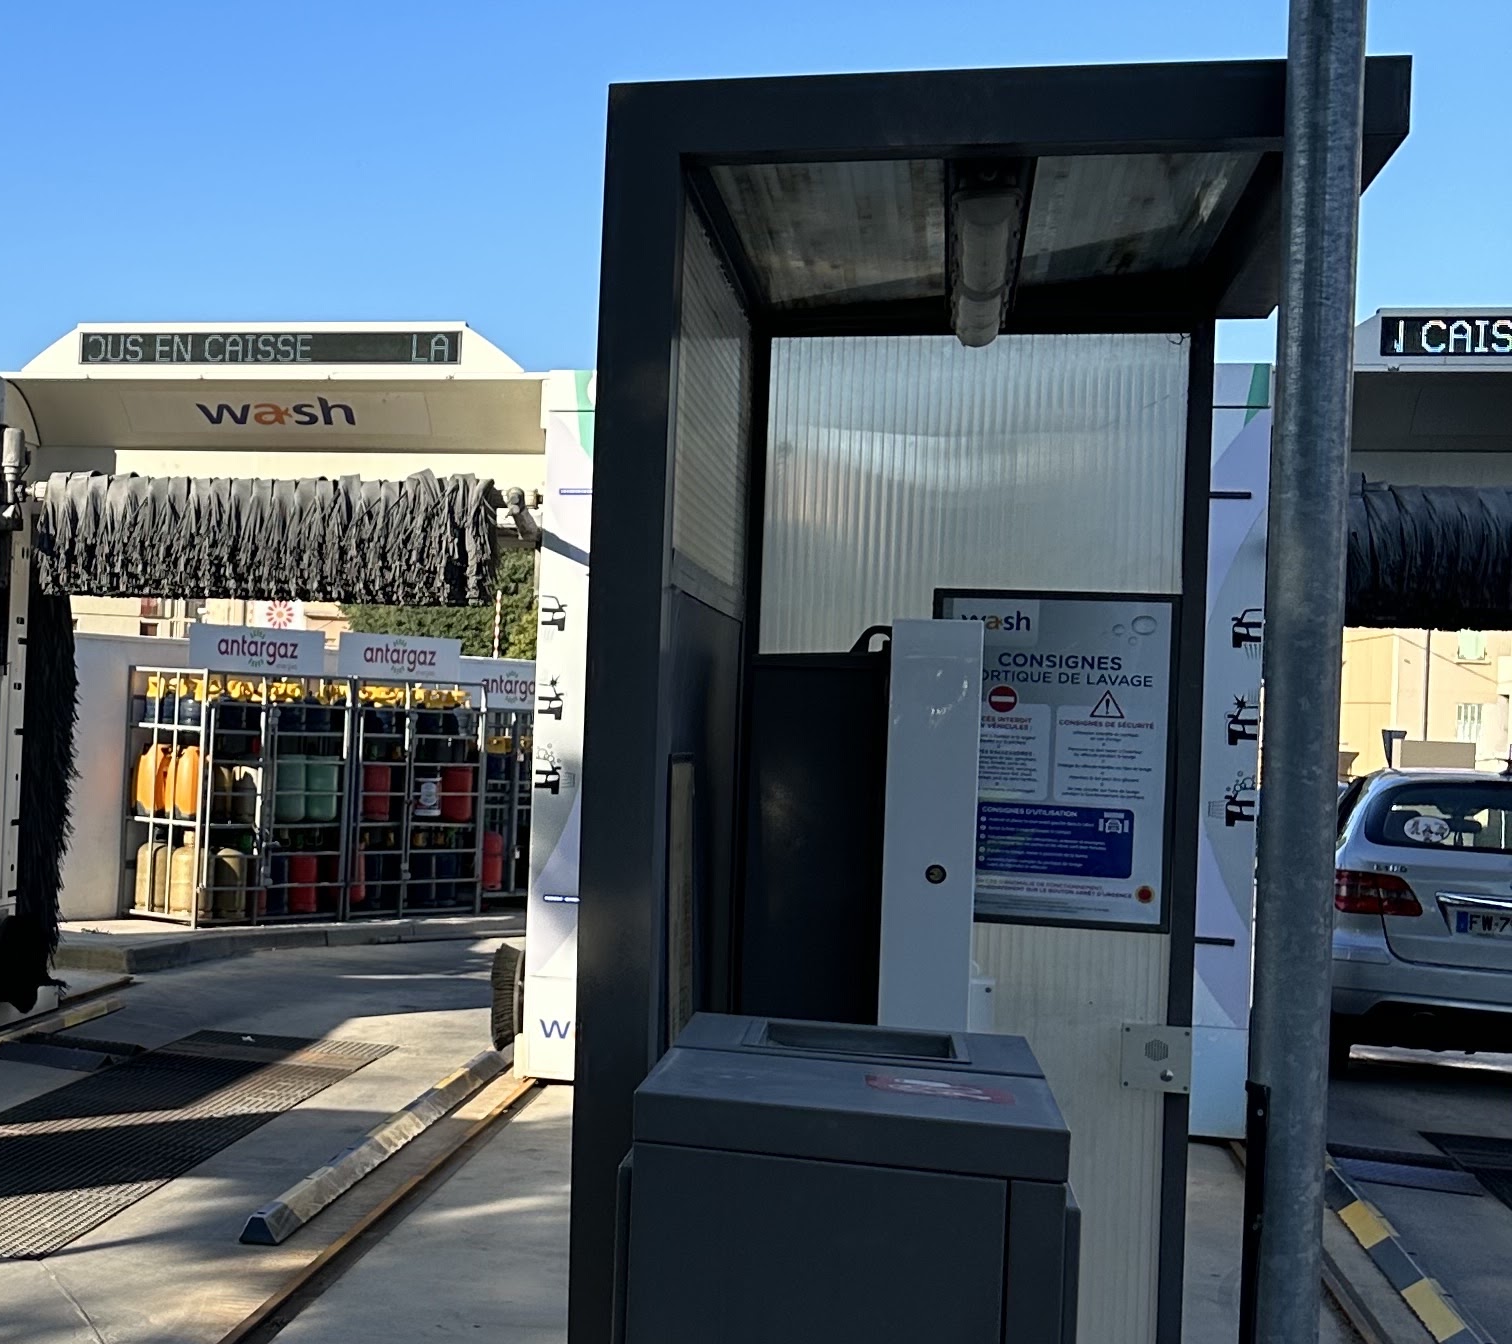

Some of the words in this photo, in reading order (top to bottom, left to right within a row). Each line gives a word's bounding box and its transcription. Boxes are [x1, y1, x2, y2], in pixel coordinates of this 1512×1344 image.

[156, 334, 192, 362] EN
[204, 334, 313, 363] CAISSE
[411, 334, 450, 363] LA
[196, 396, 357, 426] wash
[217, 634, 299, 666] antargaz
[363, 644, 437, 672] antargaz
[998, 652, 1122, 671] CONSIGNES
[983, 669, 1053, 684] ORTIQUE
[1058, 671, 1081, 685] DE
[1087, 673, 1154, 688] LAVAGE
